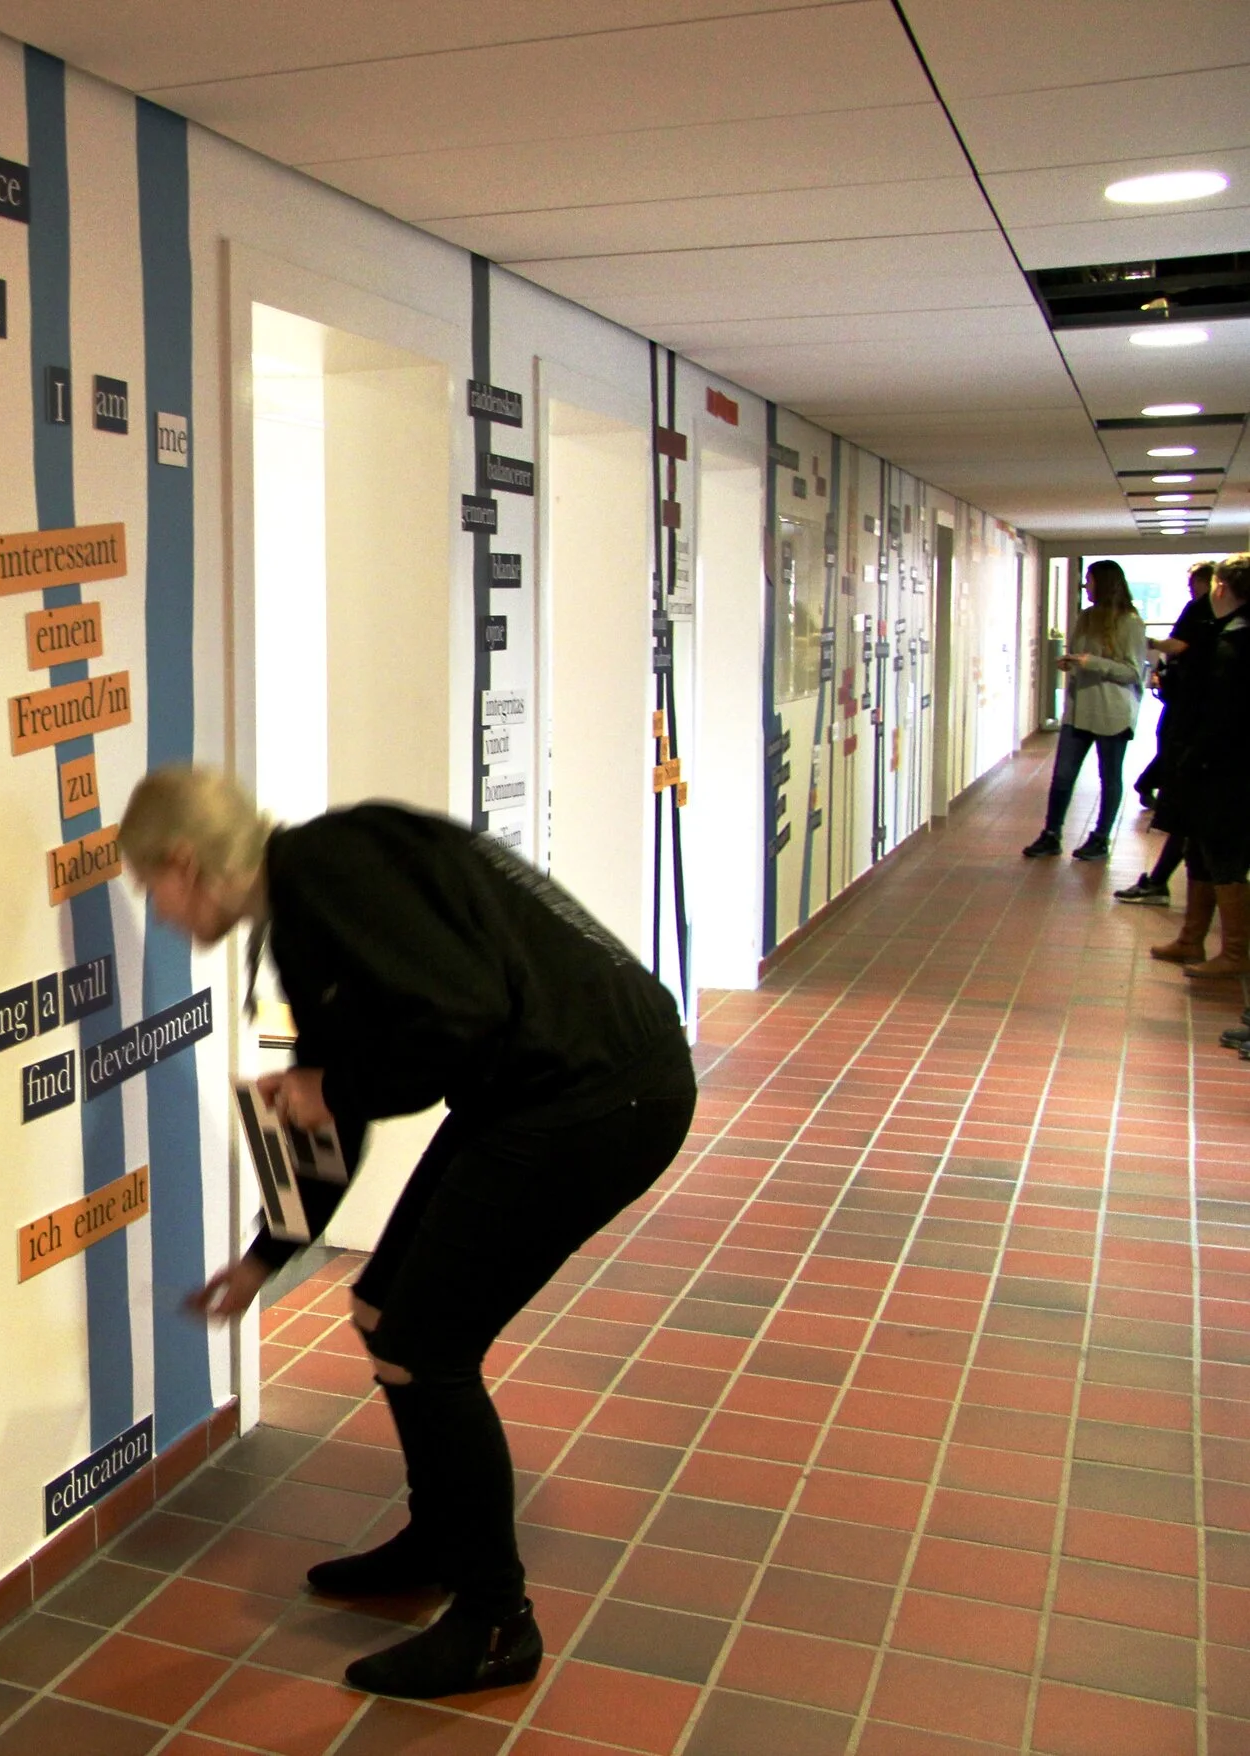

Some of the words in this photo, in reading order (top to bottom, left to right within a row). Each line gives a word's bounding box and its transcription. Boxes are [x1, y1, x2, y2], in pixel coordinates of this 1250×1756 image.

[55, 383, 67, 423] I
[95, 388, 128, 420] am
[158, 423, 188, 455] me
[36, 611, 97, 653] einen
[16, 677, 128, 738] Freund/in
[67, 771, 92, 803] zu
[52, 837, 120, 889] haben
[42, 990, 55, 1018] a
[69, 960, 106, 1006] will
[27, 1059, 71, 1106] find
[90, 1001, 210, 1085] development
[30, 1213, 61, 1263] ich
[74, 1195, 116, 1239] eine
[122, 1178, 147, 1214] alt
[50, 1430, 149, 1519] education
